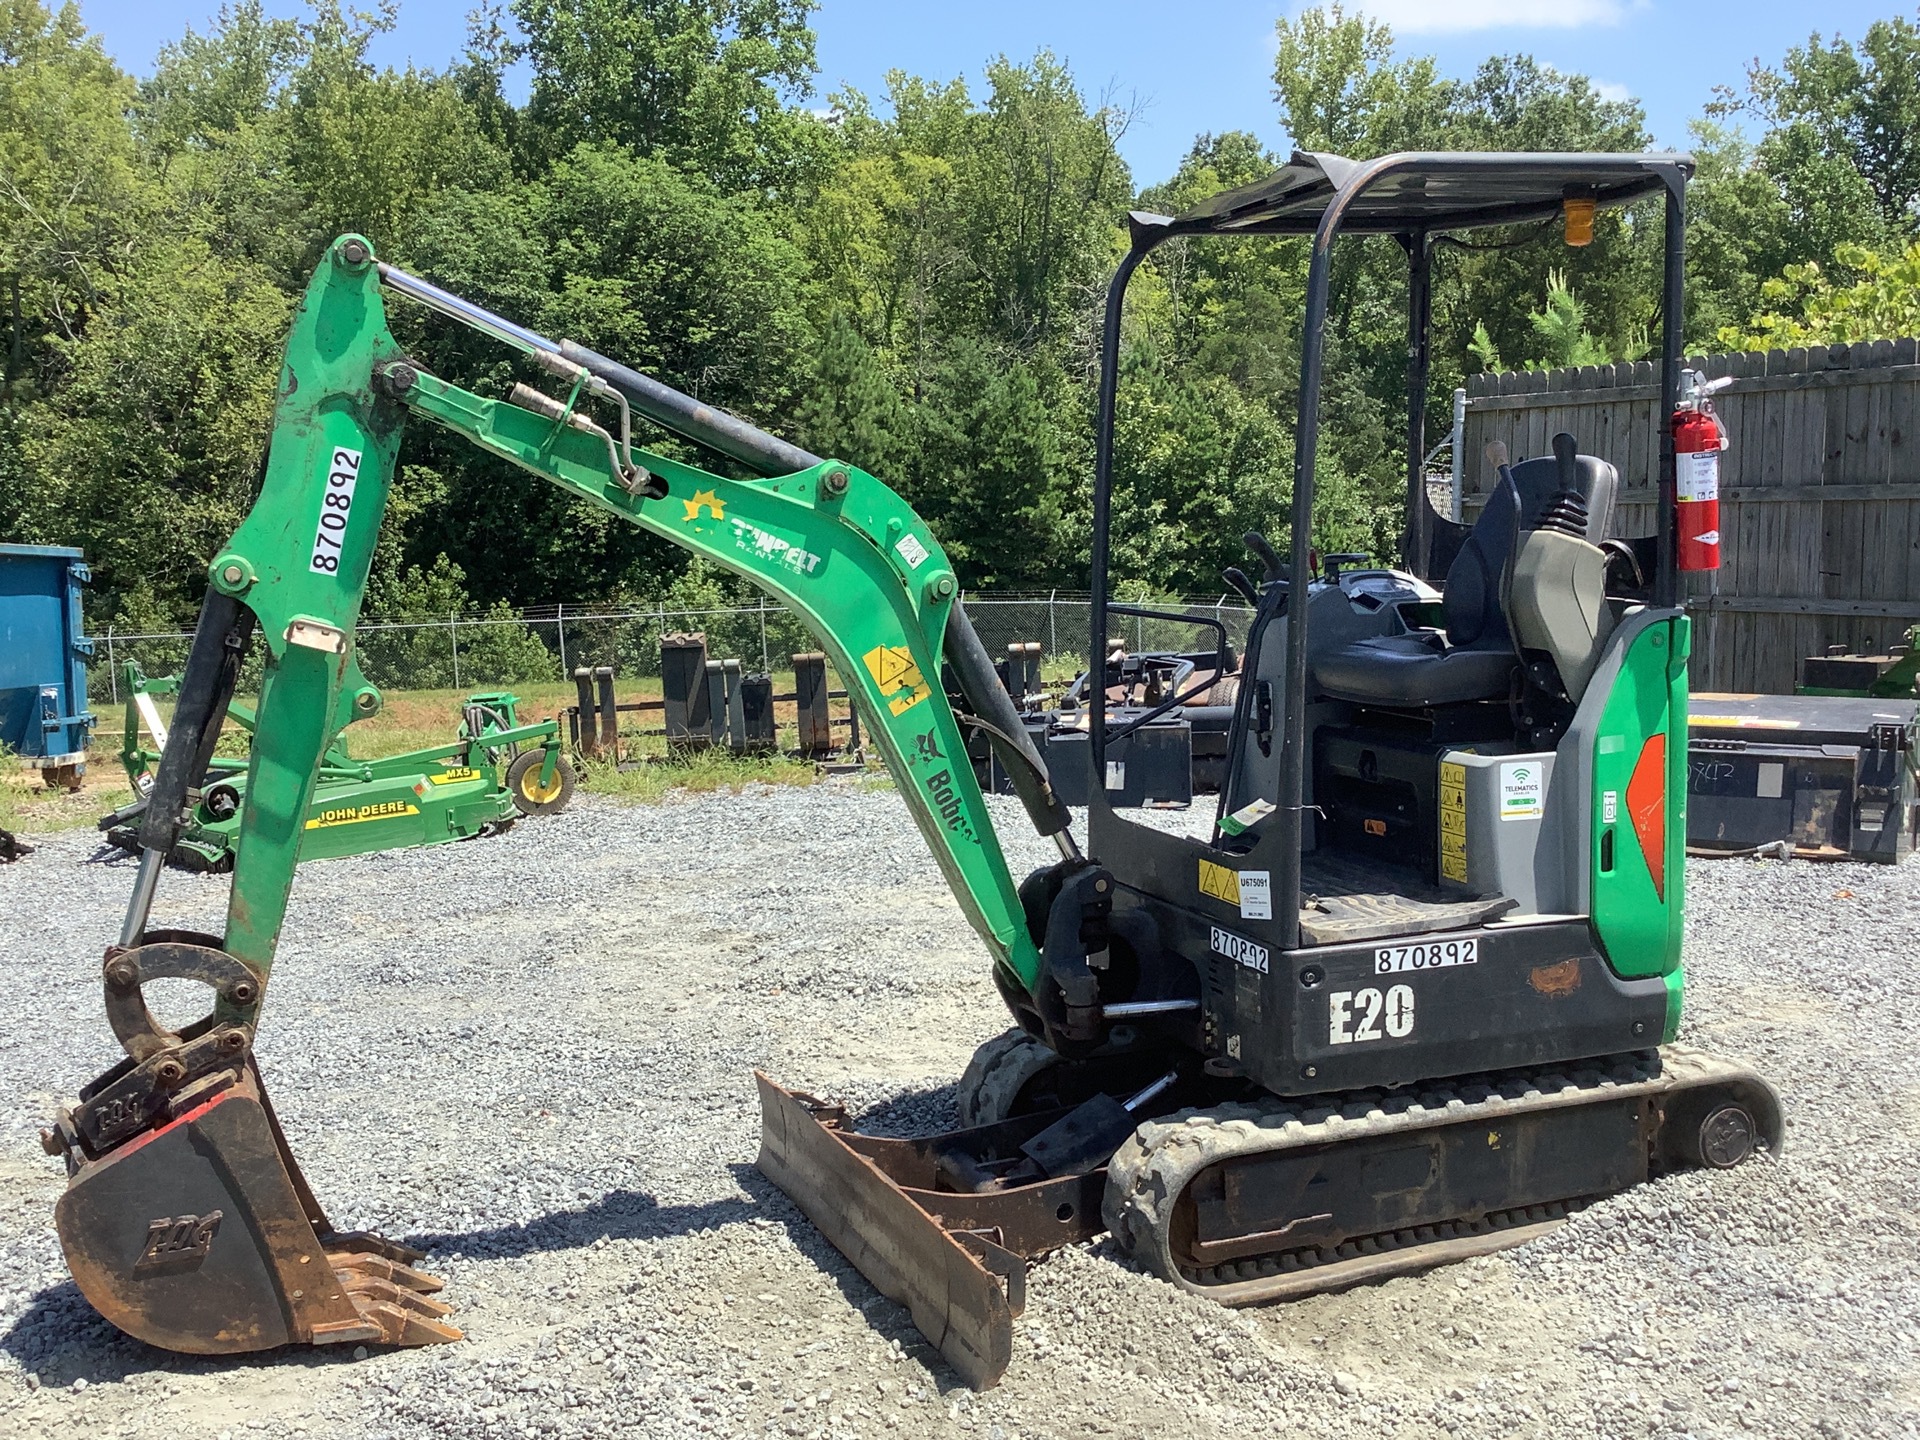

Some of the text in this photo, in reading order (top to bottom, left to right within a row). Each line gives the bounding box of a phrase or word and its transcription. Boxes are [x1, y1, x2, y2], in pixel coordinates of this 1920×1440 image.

[312, 451, 360, 572] 870892
[446, 767, 471, 779] MX5
[1505, 784, 1539, 792] TELEMATICS
[317, 800, 406, 823] JOHN DEERE
[1240, 878, 1268, 888] U675091
[1378, 940, 1475, 973] 870892
[1329, 984, 1415, 1045] E20
